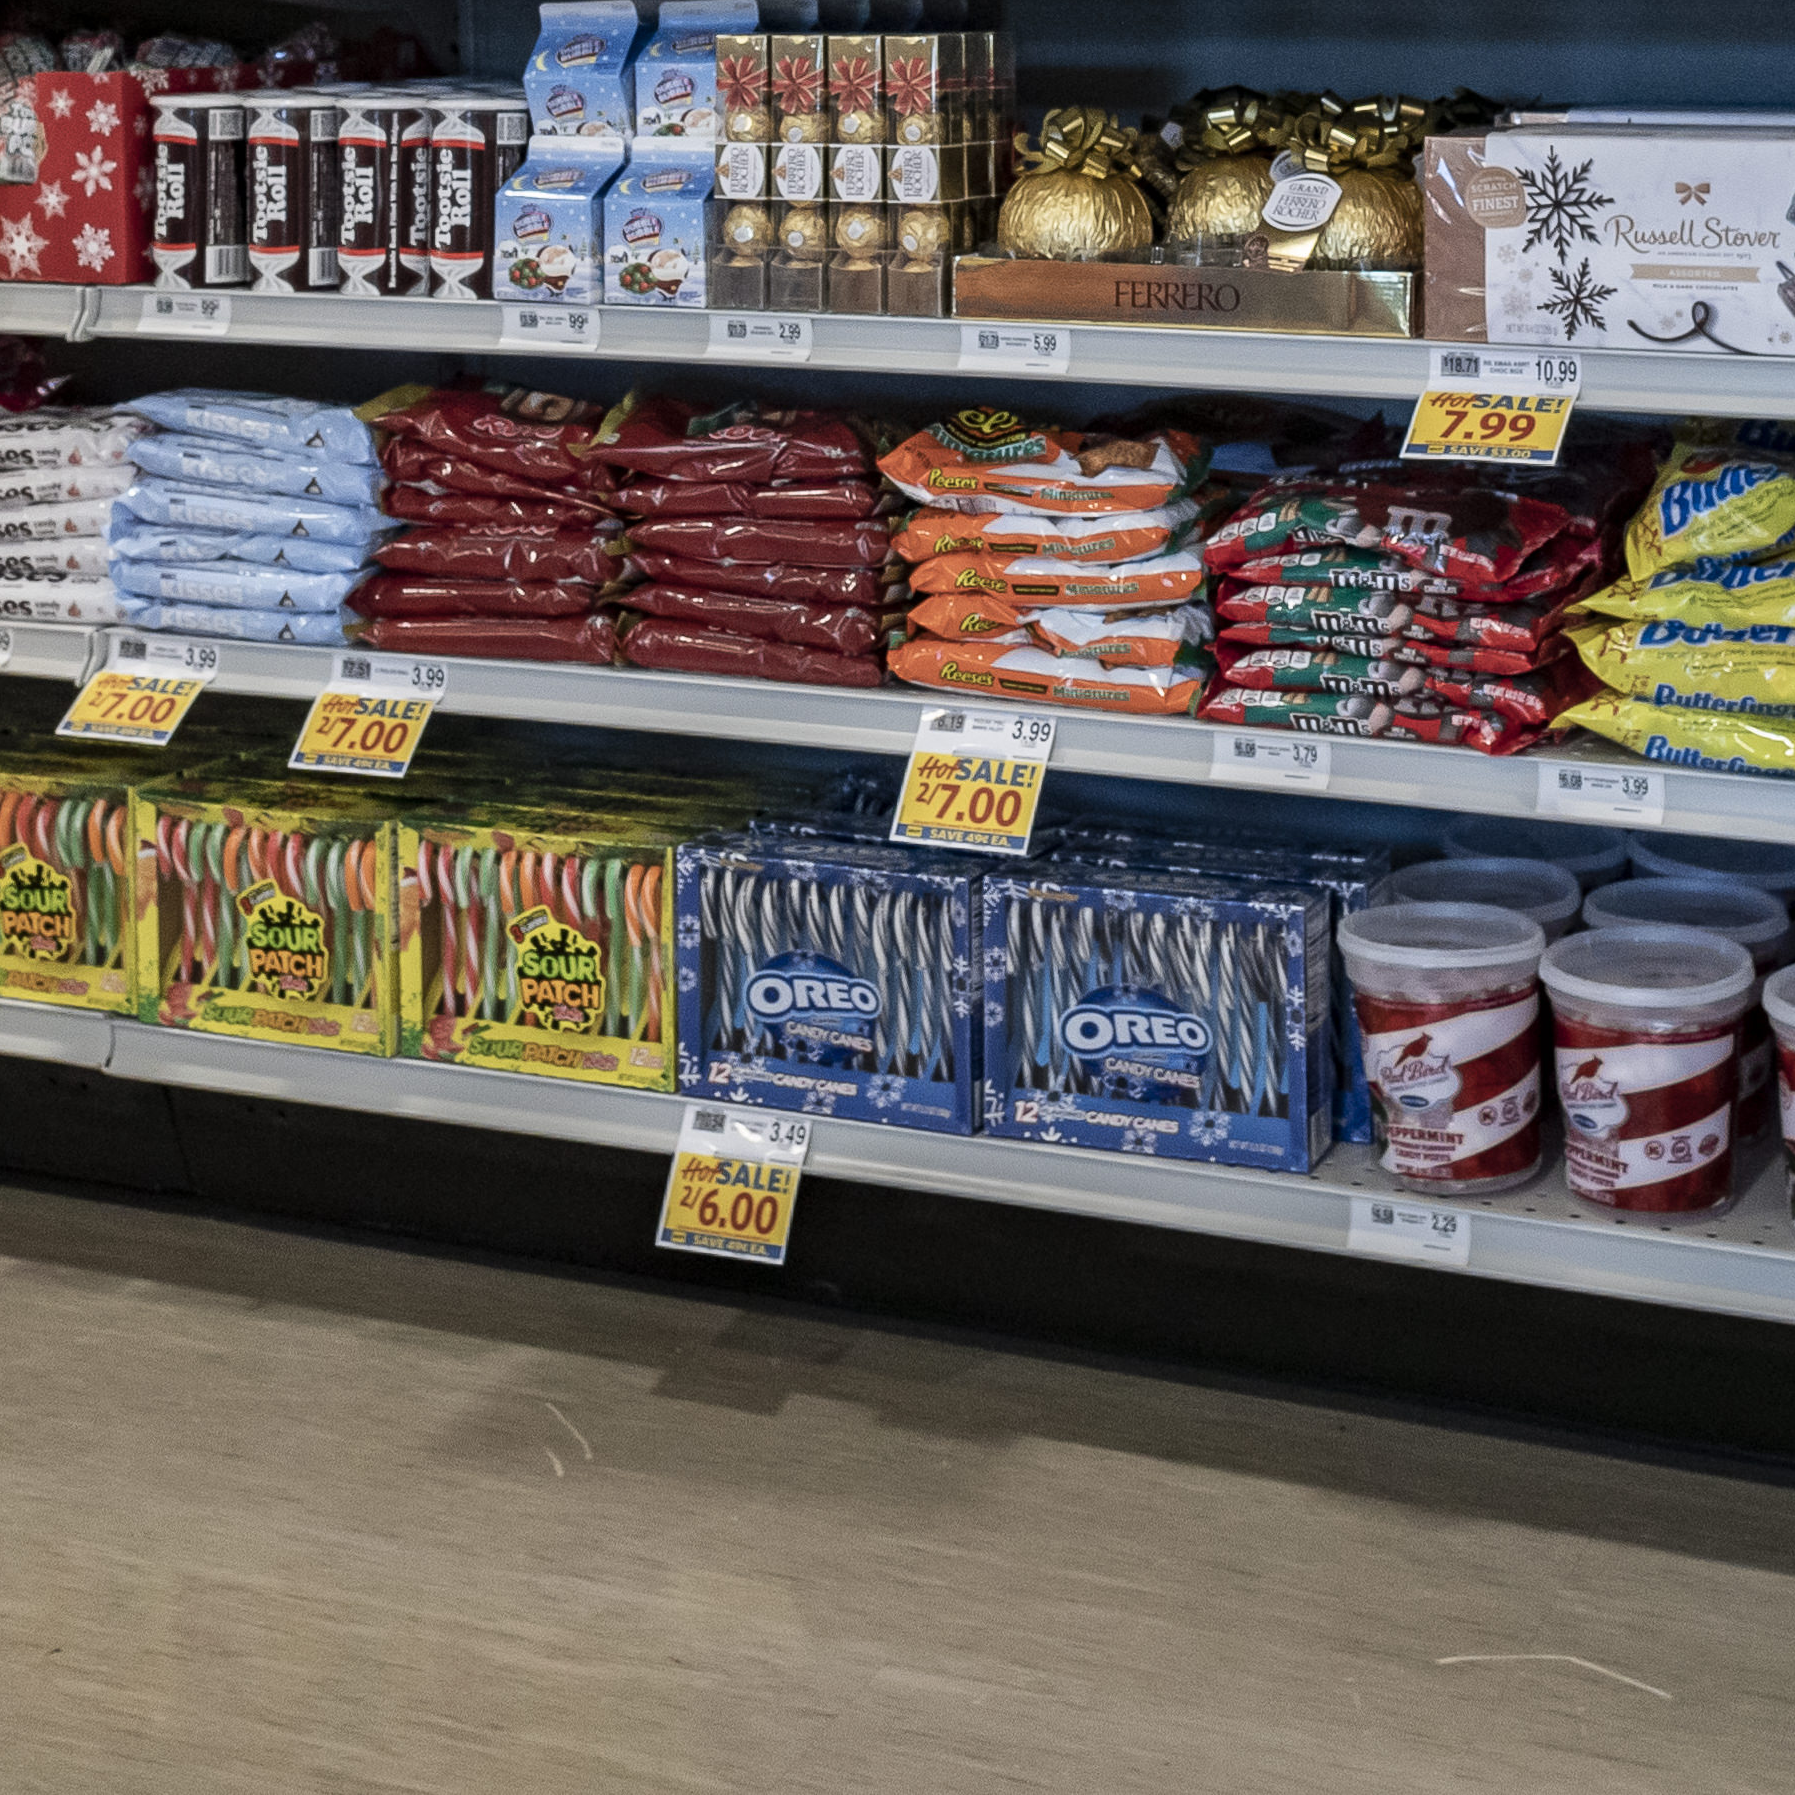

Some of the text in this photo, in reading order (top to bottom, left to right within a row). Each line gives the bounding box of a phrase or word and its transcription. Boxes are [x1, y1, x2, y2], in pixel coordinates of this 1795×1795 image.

[340, 147, 356, 244] Tootsie
[355, 166, 374, 223] Roll
[1287, 182, 1329, 198] GRAND
[1472, 197, 1520, 212] FINEST
[1605, 214, 1781, 254] Russell Stover
[1114, 281, 1241, 313] FERRERO
[1034, 334, 1057, 352] 5.99
[1535, 360, 1577, 382] 10.99
[1472, 394, 1566, 413] SALE!
[1440, 410, 1536, 442] 7.99
[1449, 446, 1531, 458] SAVE $3.00
[411, 667, 444, 687] 3.99
[941, 662, 1130, 703] Reese's Miniatures
[1013, 721, 1051, 741] 3.99
[955, 759, 1037, 788] SALE!
[930, 829, 963, 841] SAVE
[522, 951, 597, 980] SOUR
[521, 978, 600, 1007] PATCH
[747, 977, 880, 1012] OREO
[786, 1020, 873, 1052] CANDY CANES
[768, 1121, 806, 1144] 3.49
[716, 1161, 791, 1193] SALE!
